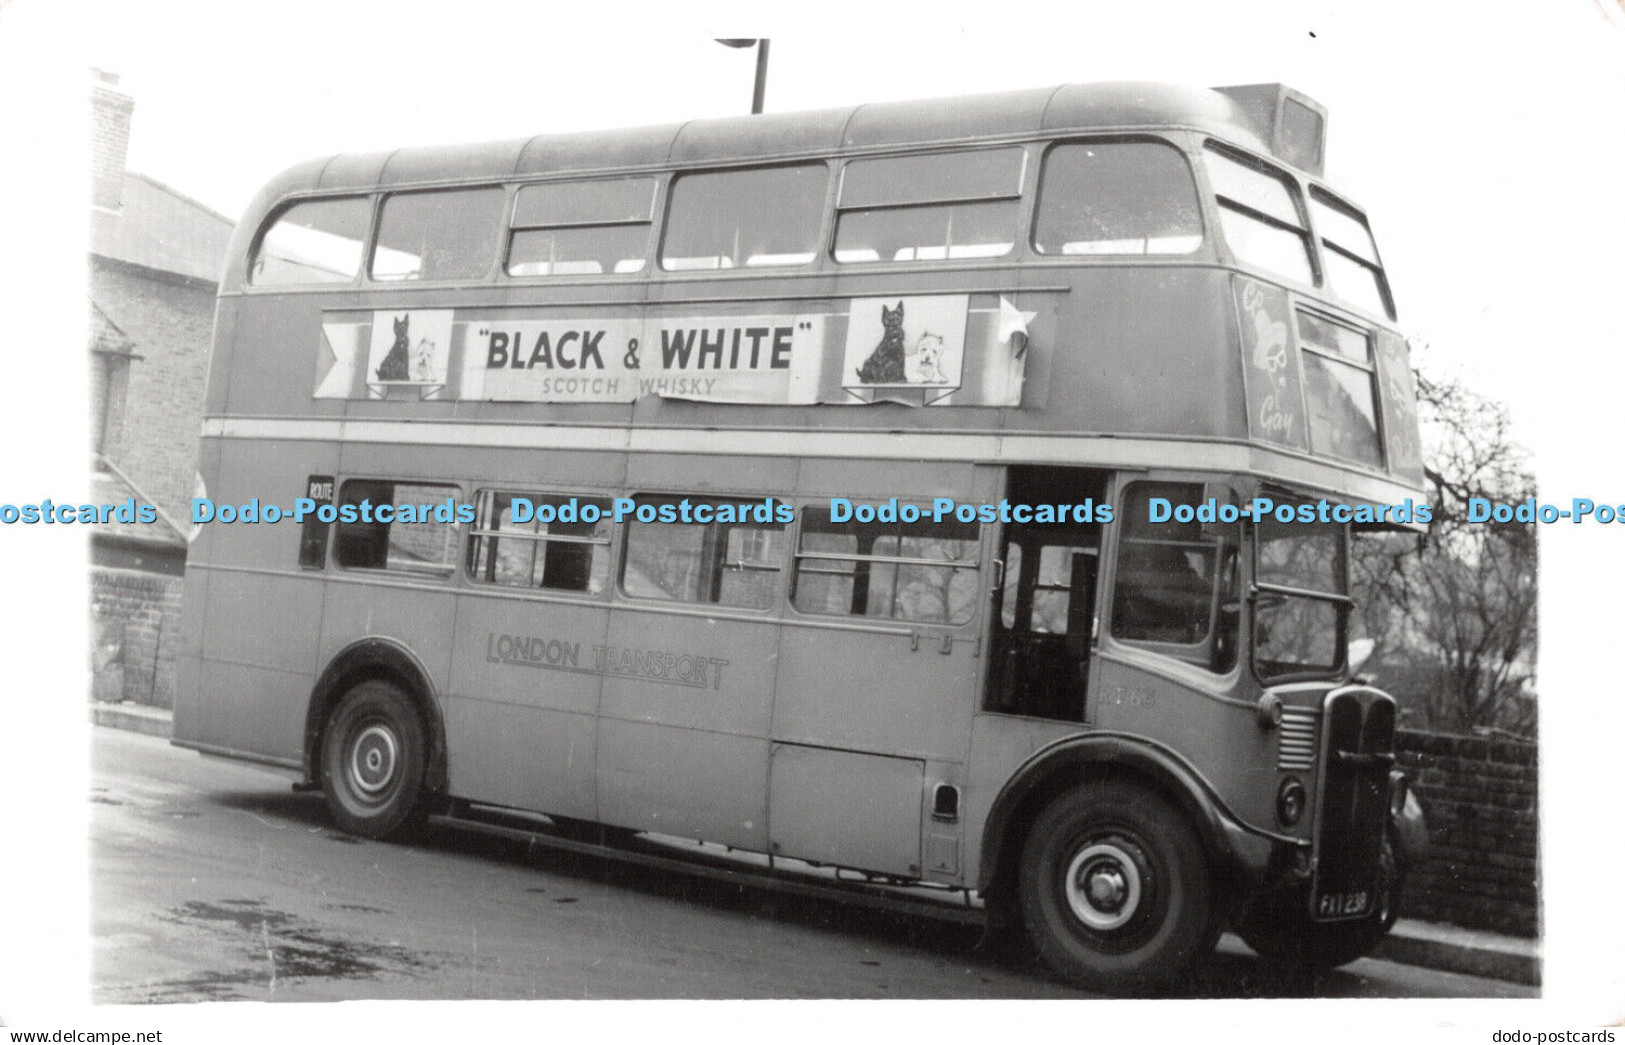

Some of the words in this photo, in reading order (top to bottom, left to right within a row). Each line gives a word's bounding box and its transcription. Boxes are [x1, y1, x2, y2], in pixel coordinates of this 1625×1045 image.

[623, 337, 641, 370] &
[542, 377, 619, 395] SCOTCH
[638, 376, 717, 396] WHISKY
[309, 482, 334, 500] ROUTE
[487, 632, 581, 667] LONDON
[592, 644, 731, 691] TRANSPORT
